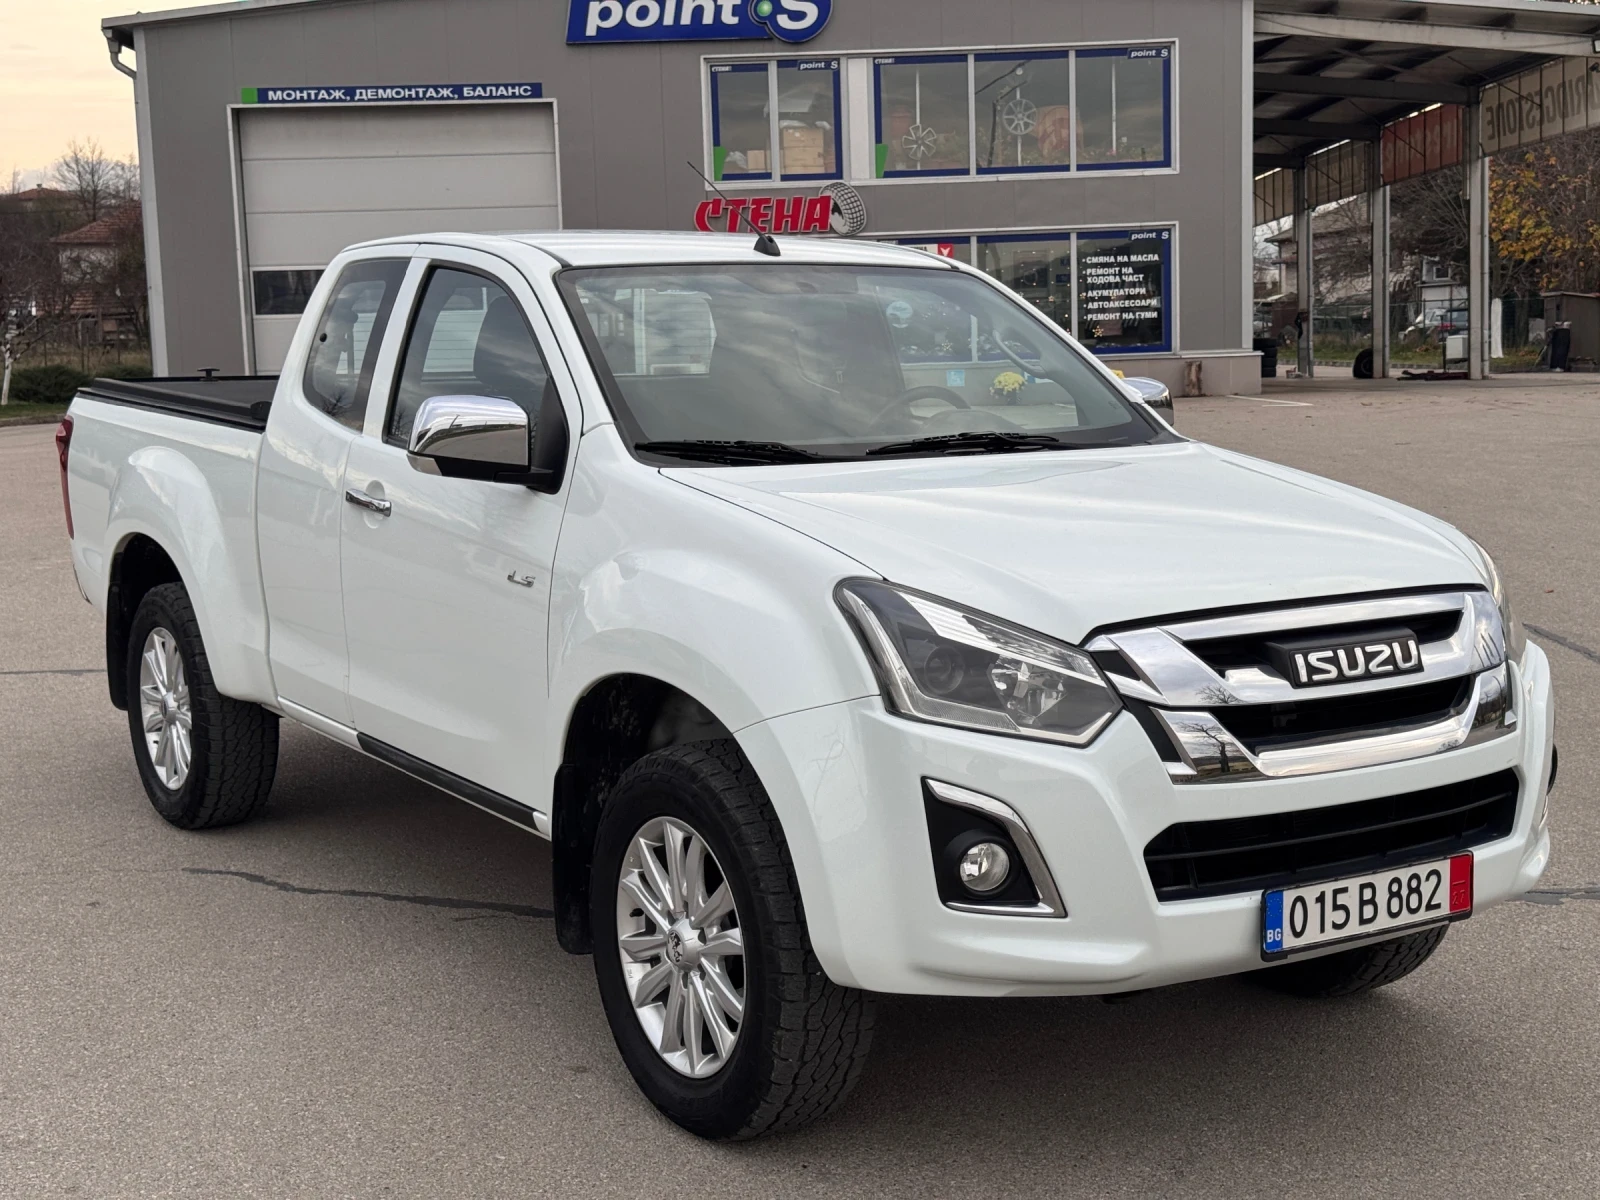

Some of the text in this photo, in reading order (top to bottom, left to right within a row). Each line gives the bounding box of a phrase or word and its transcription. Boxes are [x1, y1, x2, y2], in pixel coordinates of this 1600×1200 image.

[585, 0, 819, 36] point S
[1131, 48, 1168, 58] point S
[799, 60, 839, 71] point S
[267, 85, 533, 101] МОНТАЖ, ДЕМОНТАЖ, БАЛАНС
[694, 195, 832, 234] СТЕНА
[1131, 231, 1169, 240] point S
[1086, 256, 1115, 264] СМЯНА
[1130, 254, 1159, 262] МАСЛА
[1086, 267, 1120, 275] РЕМОНТ
[1087, 274, 1144, 284] ХОДОВА ЧАСТ
[1087, 288, 1146, 297] АКУМУЛАТОРИ
[1087, 299, 1157, 309] АВТОАКСЕСОАРИ
[1087, 313, 1120, 321] РЕМОНТ
[1136, 311, 1158, 319] ГУМИ
[1294, 639, 1419, 683] ISUZU
[1266, 928, 1281, 942] BG
